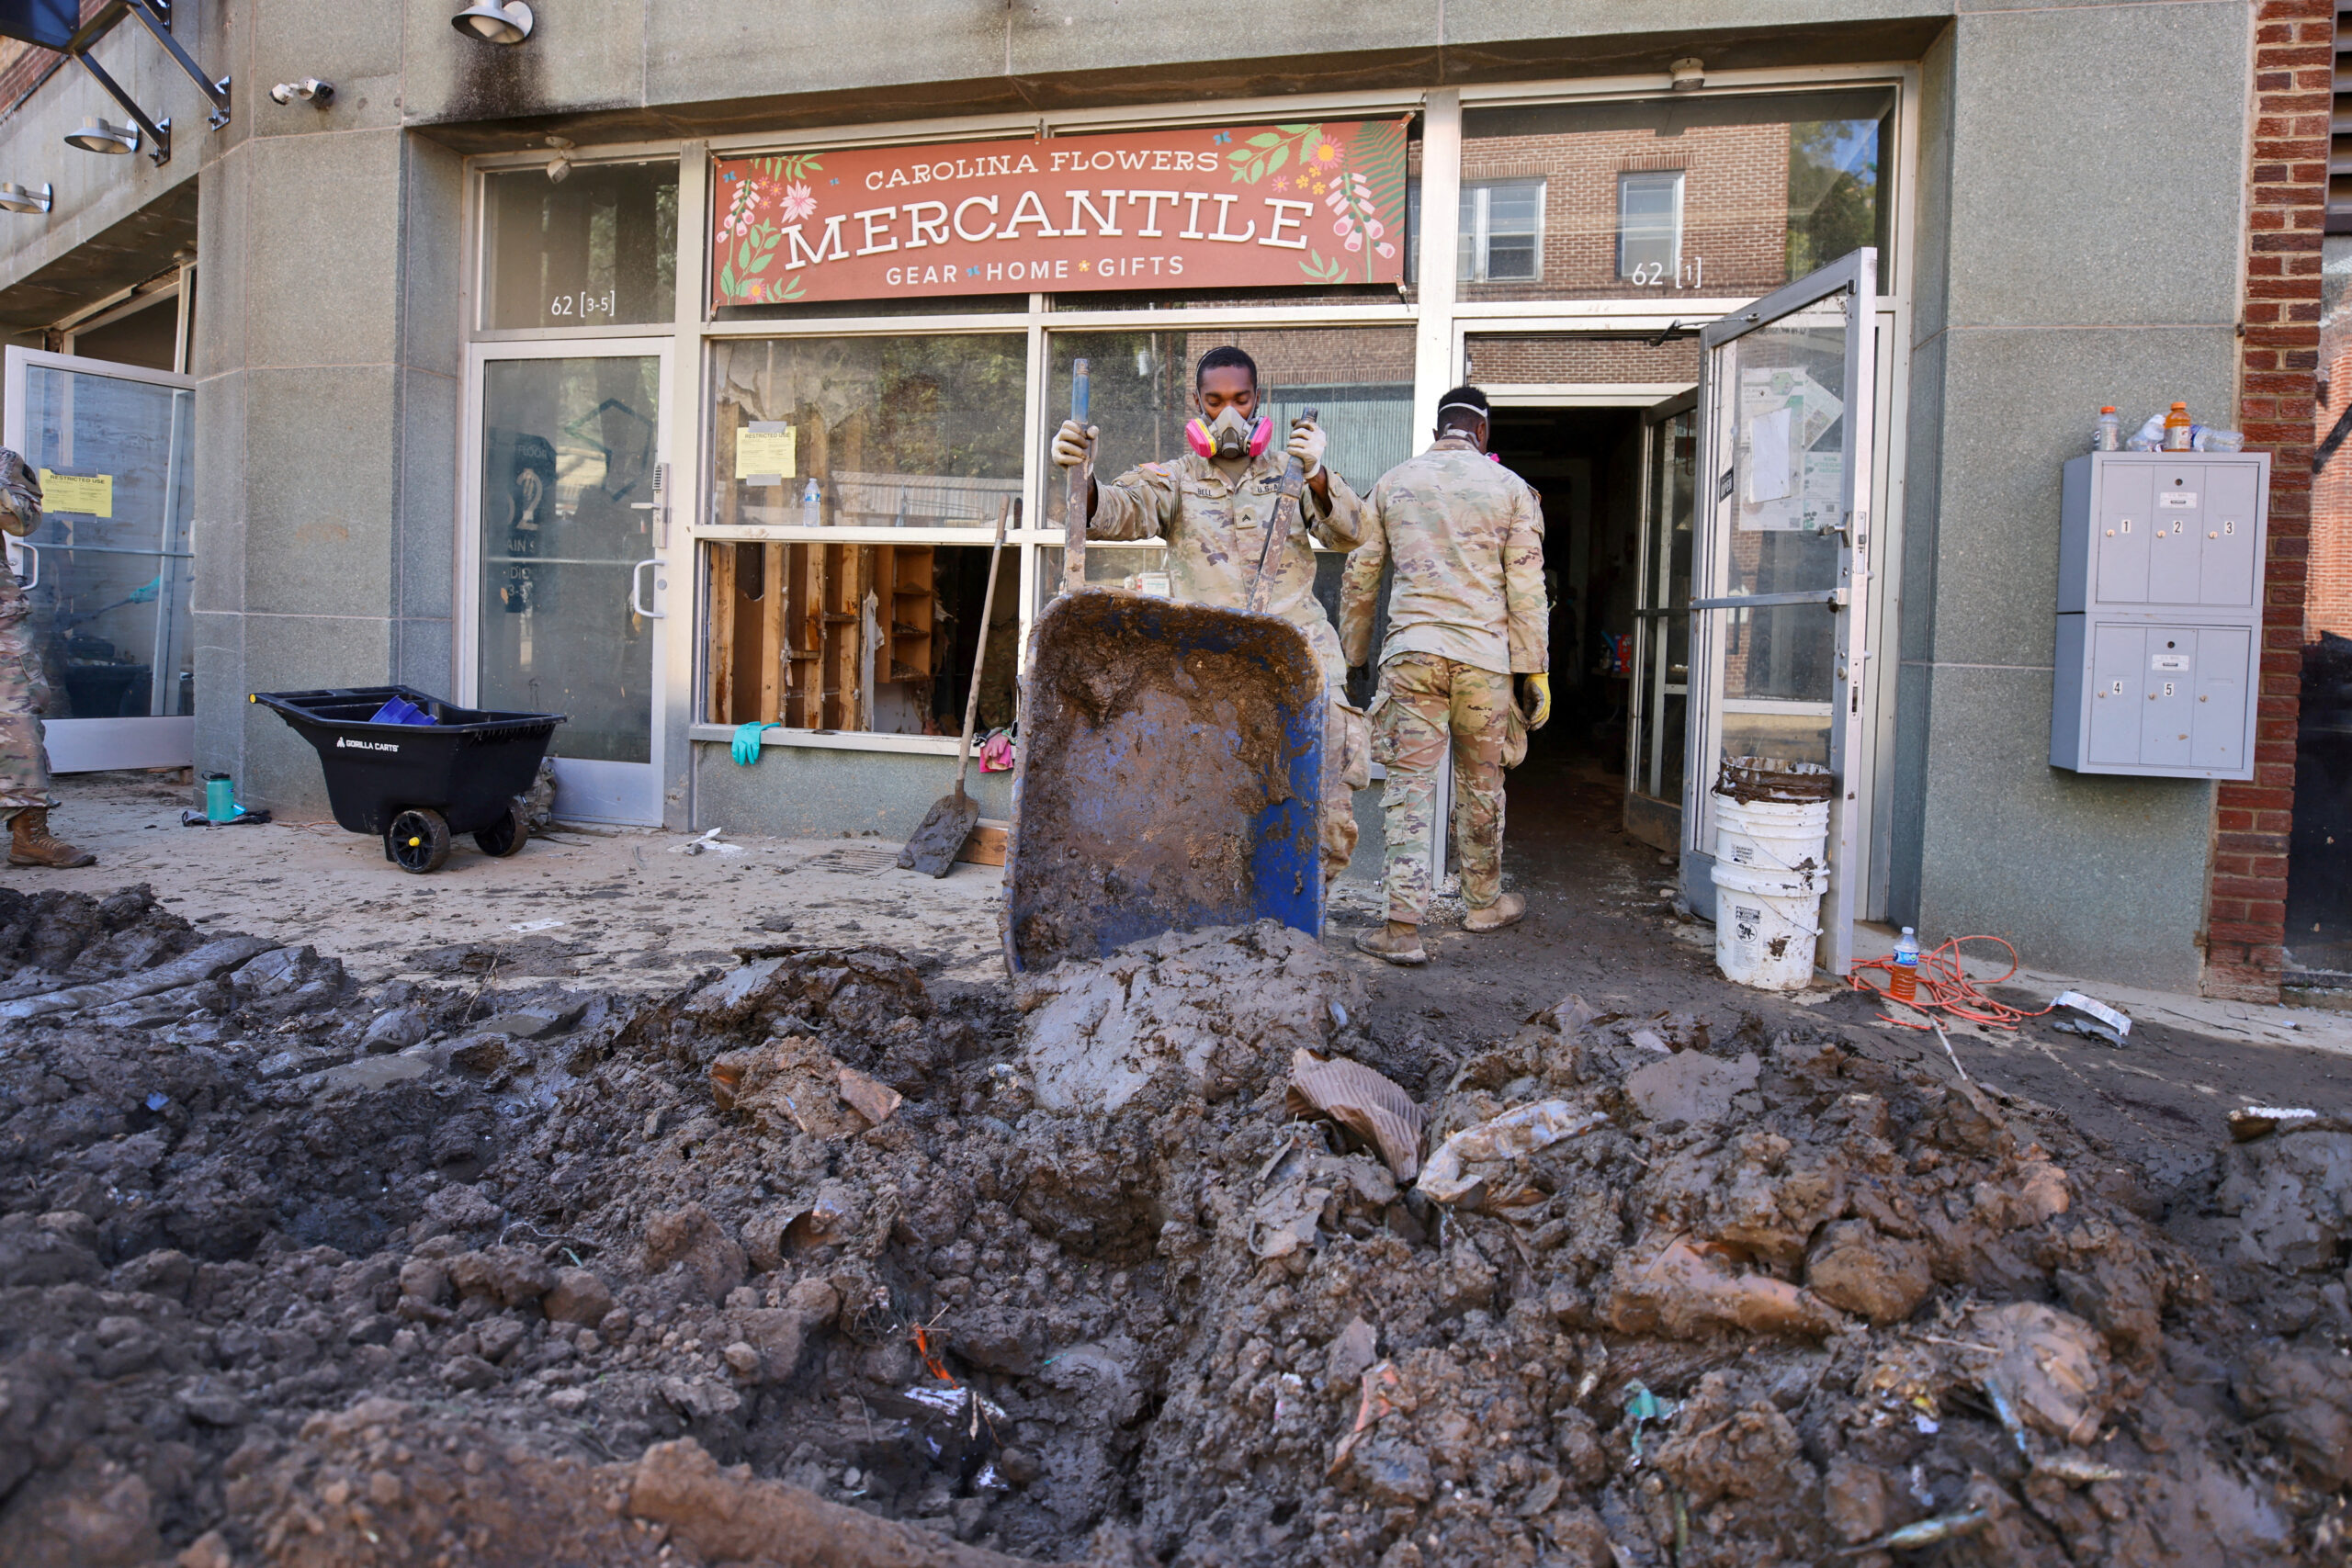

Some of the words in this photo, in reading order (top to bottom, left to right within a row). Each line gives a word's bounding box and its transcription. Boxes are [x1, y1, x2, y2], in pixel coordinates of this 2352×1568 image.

[865, 153, 1038, 191] CAROLINA
[1050, 150, 1219, 173] FLOWERS
[781, 189, 1314, 271] MERCANTILE
[886, 265, 957, 287] GEAR
[986, 259, 1069, 282] HOME
[1097, 255, 1184, 277] GIFTS
[1632, 262, 1663, 286] 62
[1675, 256, 1702, 289] [1]
[551, 295, 572, 316] 62
[580, 289, 616, 318] [3-5]
[1197, 488, 1213, 497] BELL
[2123, 520, 2129, 532] 1
[2174, 521, 2181, 534] 2
[2226, 522, 2233, 534] 3
[2113, 682, 2120, 694] 4
[2165, 683, 2172, 695] 5
[345, 739, 374, 750] GORILLA
[374, 742, 399, 752] CARTS
